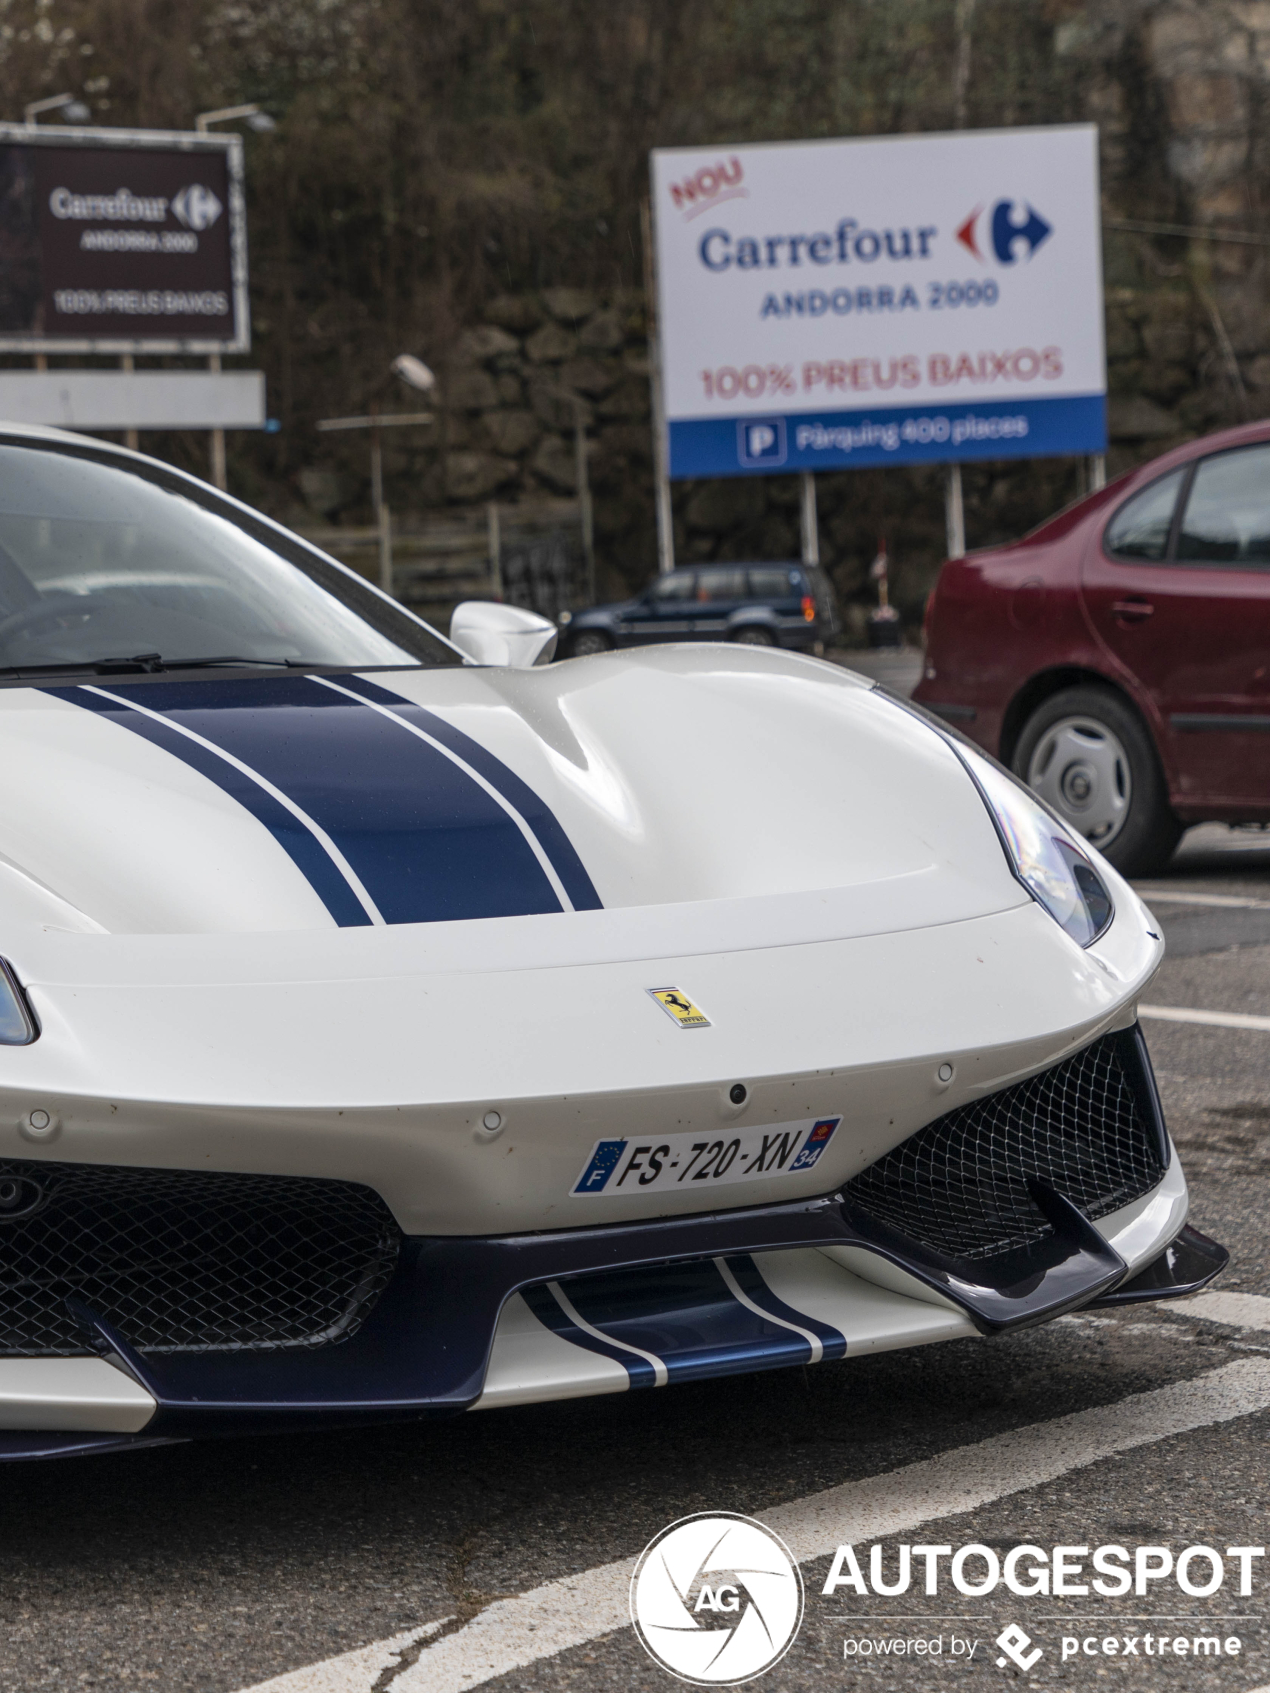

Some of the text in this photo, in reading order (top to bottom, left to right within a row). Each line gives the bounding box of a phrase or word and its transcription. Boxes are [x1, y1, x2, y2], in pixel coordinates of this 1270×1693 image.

[49, 186, 169, 222] Carrefour
[669, 156, 744, 210] NOU
[81, 229, 159, 252] ANDORRA
[698, 217, 937, 272] Carrefour
[101, 289, 162, 315] PREUS
[162, 290, 229, 316] BAIXOS
[760, 278, 999, 321] ANDORRA 2000
[699, 344, 1064, 401] 100% PREUS BAIXOS
[901, 416, 951, 443] 400
[951, 414, 1029, 446] places
[586, 1130, 821, 1187] F FS-720-XN 34
